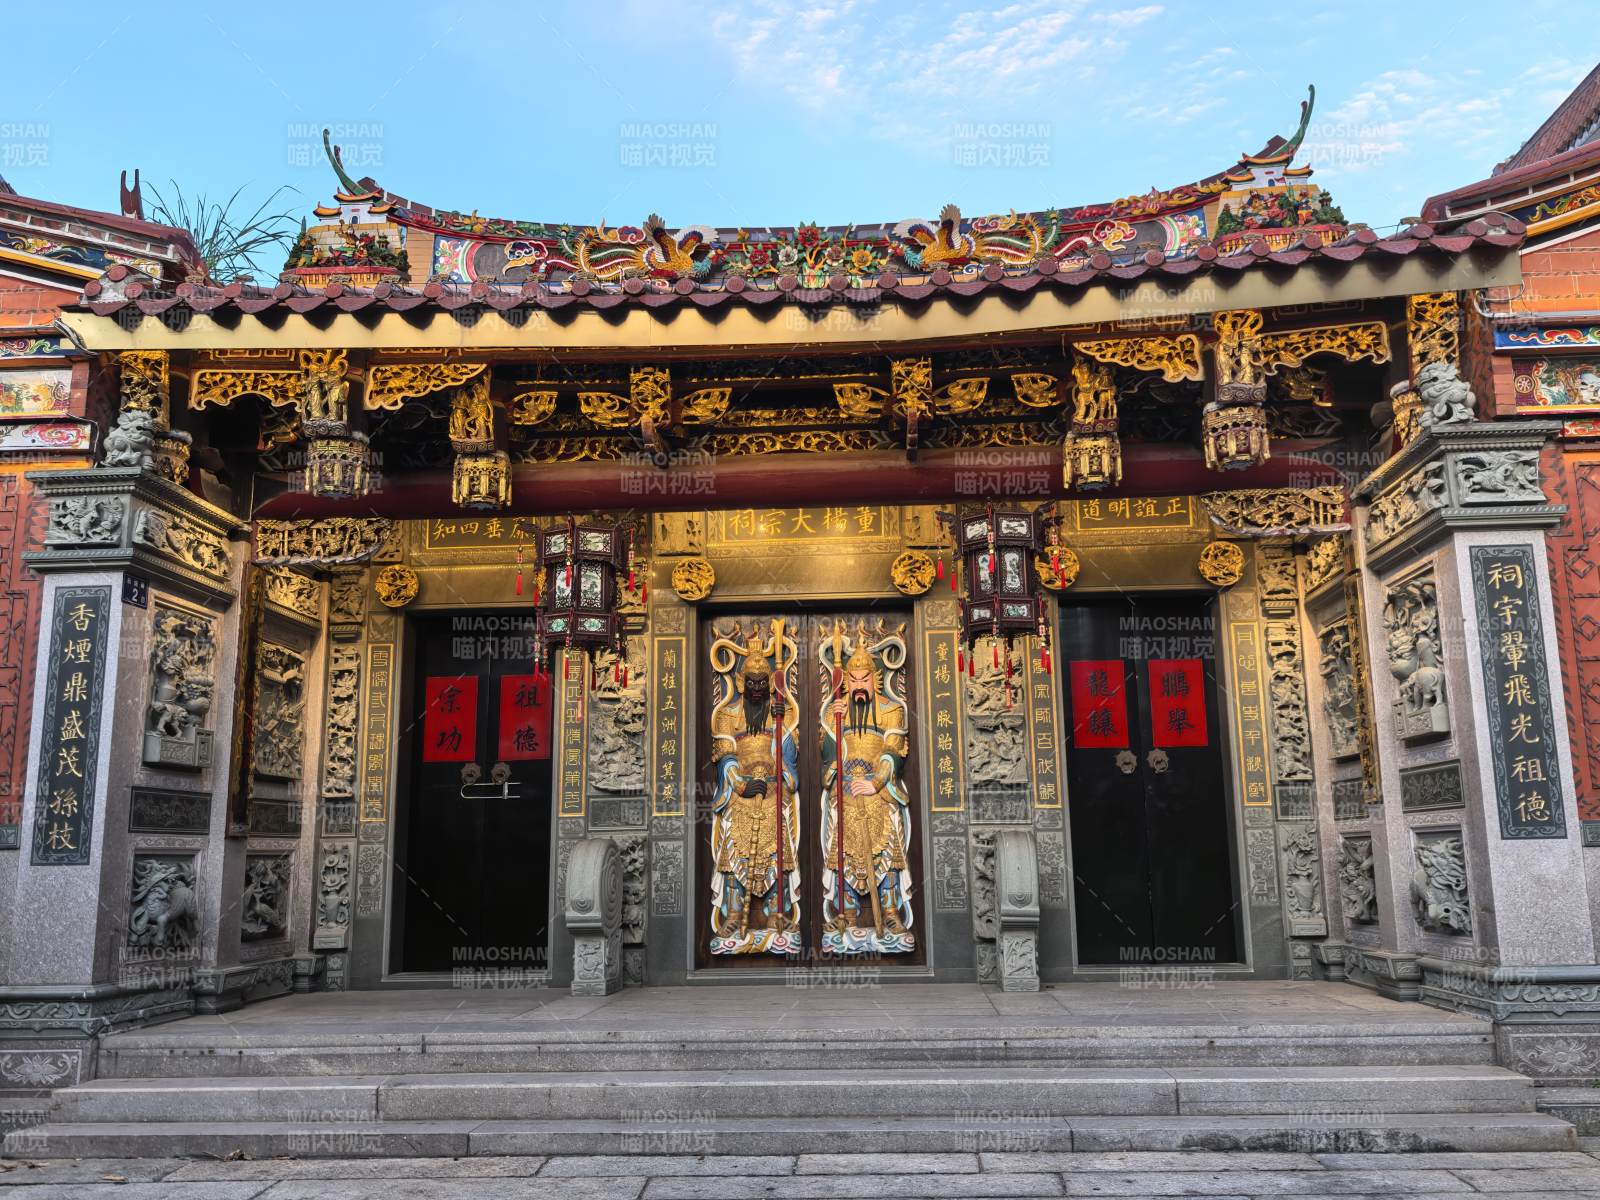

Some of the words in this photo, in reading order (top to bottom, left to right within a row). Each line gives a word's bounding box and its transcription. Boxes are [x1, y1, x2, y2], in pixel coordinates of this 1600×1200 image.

[729, 506, 878, 535] 董楊大宗祠
[1082, 497, 1187, 520] 正誼明道
[46, 603, 96, 850] 香煙鼎盛茂孫枝
[513, 683, 541, 752] 祖德
[1487, 562, 1551, 822] 祠宇翬飛光祖德
